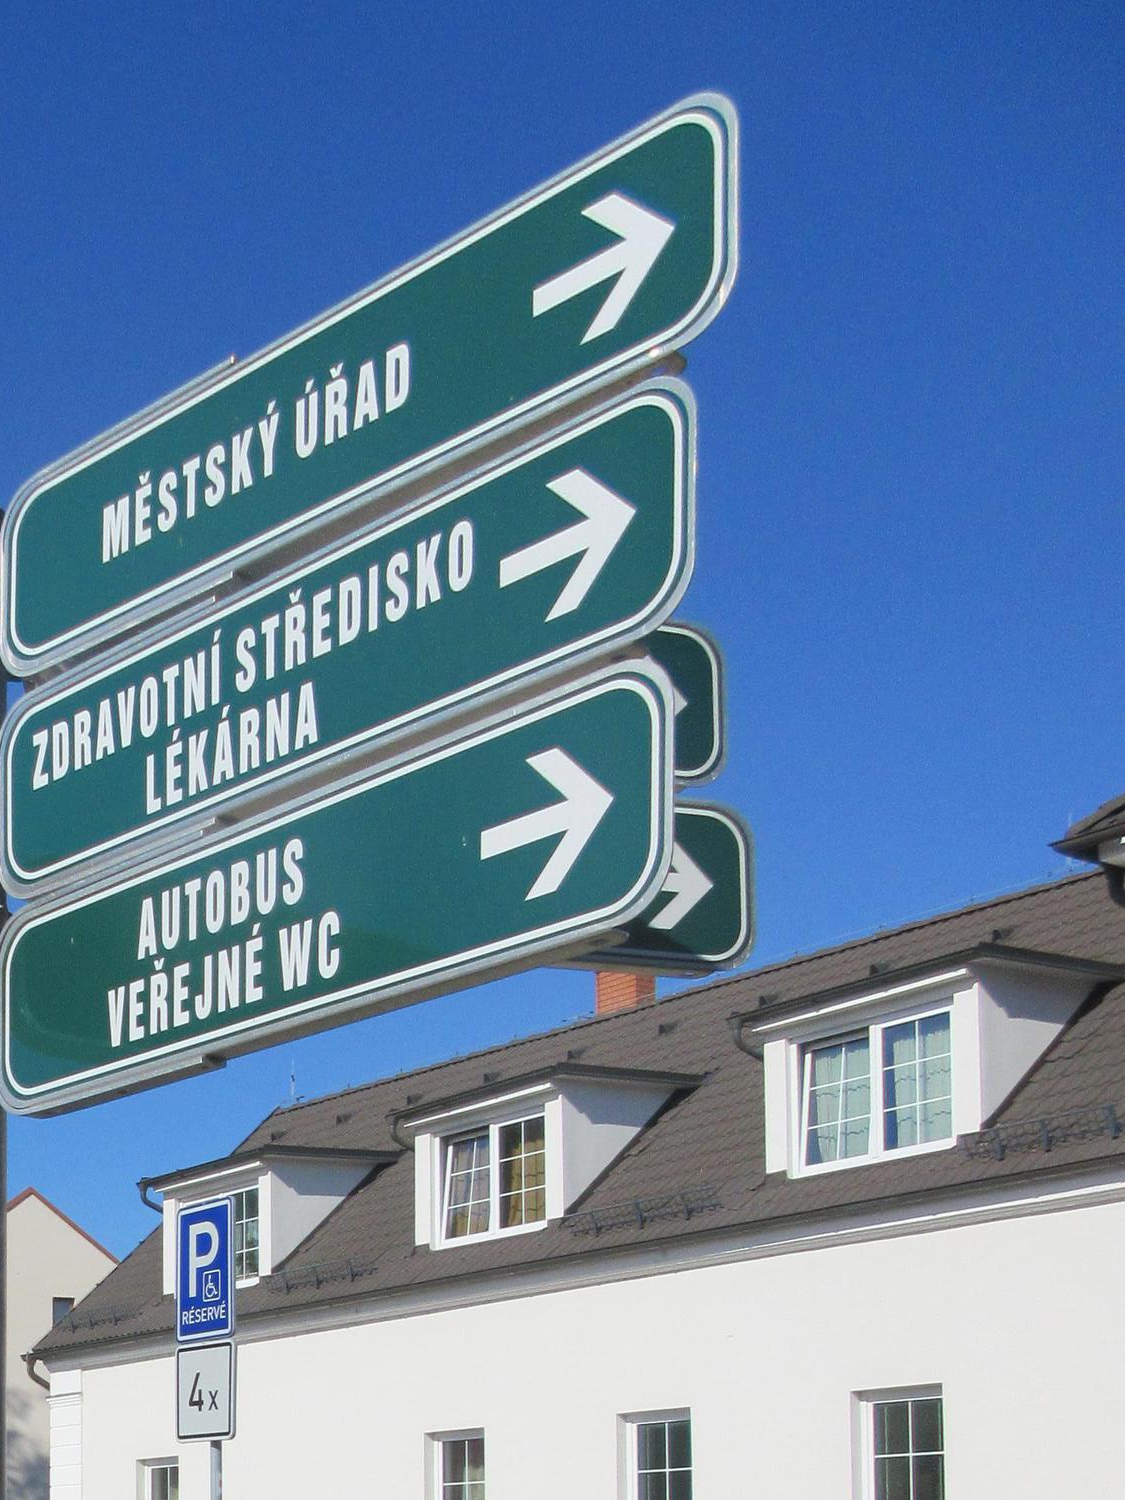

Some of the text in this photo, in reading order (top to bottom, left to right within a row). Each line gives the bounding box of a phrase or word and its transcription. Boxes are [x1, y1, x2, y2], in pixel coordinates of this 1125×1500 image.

[102, 343, 410, 563] MĚSTSKÝ ÚŘAD
[32, 520, 474, 791] ZDRAVOTNÍ STŘEDISKO
[146, 681, 318, 815] LÉKÁRNA
[136, 837, 305, 961] AUTOBUS
[107, 911, 342, 1048] VEŘEJNÉ WC
[181, 1300, 227, 1326] RÉSERVÉ
[188, 1221, 220, 1298] P
